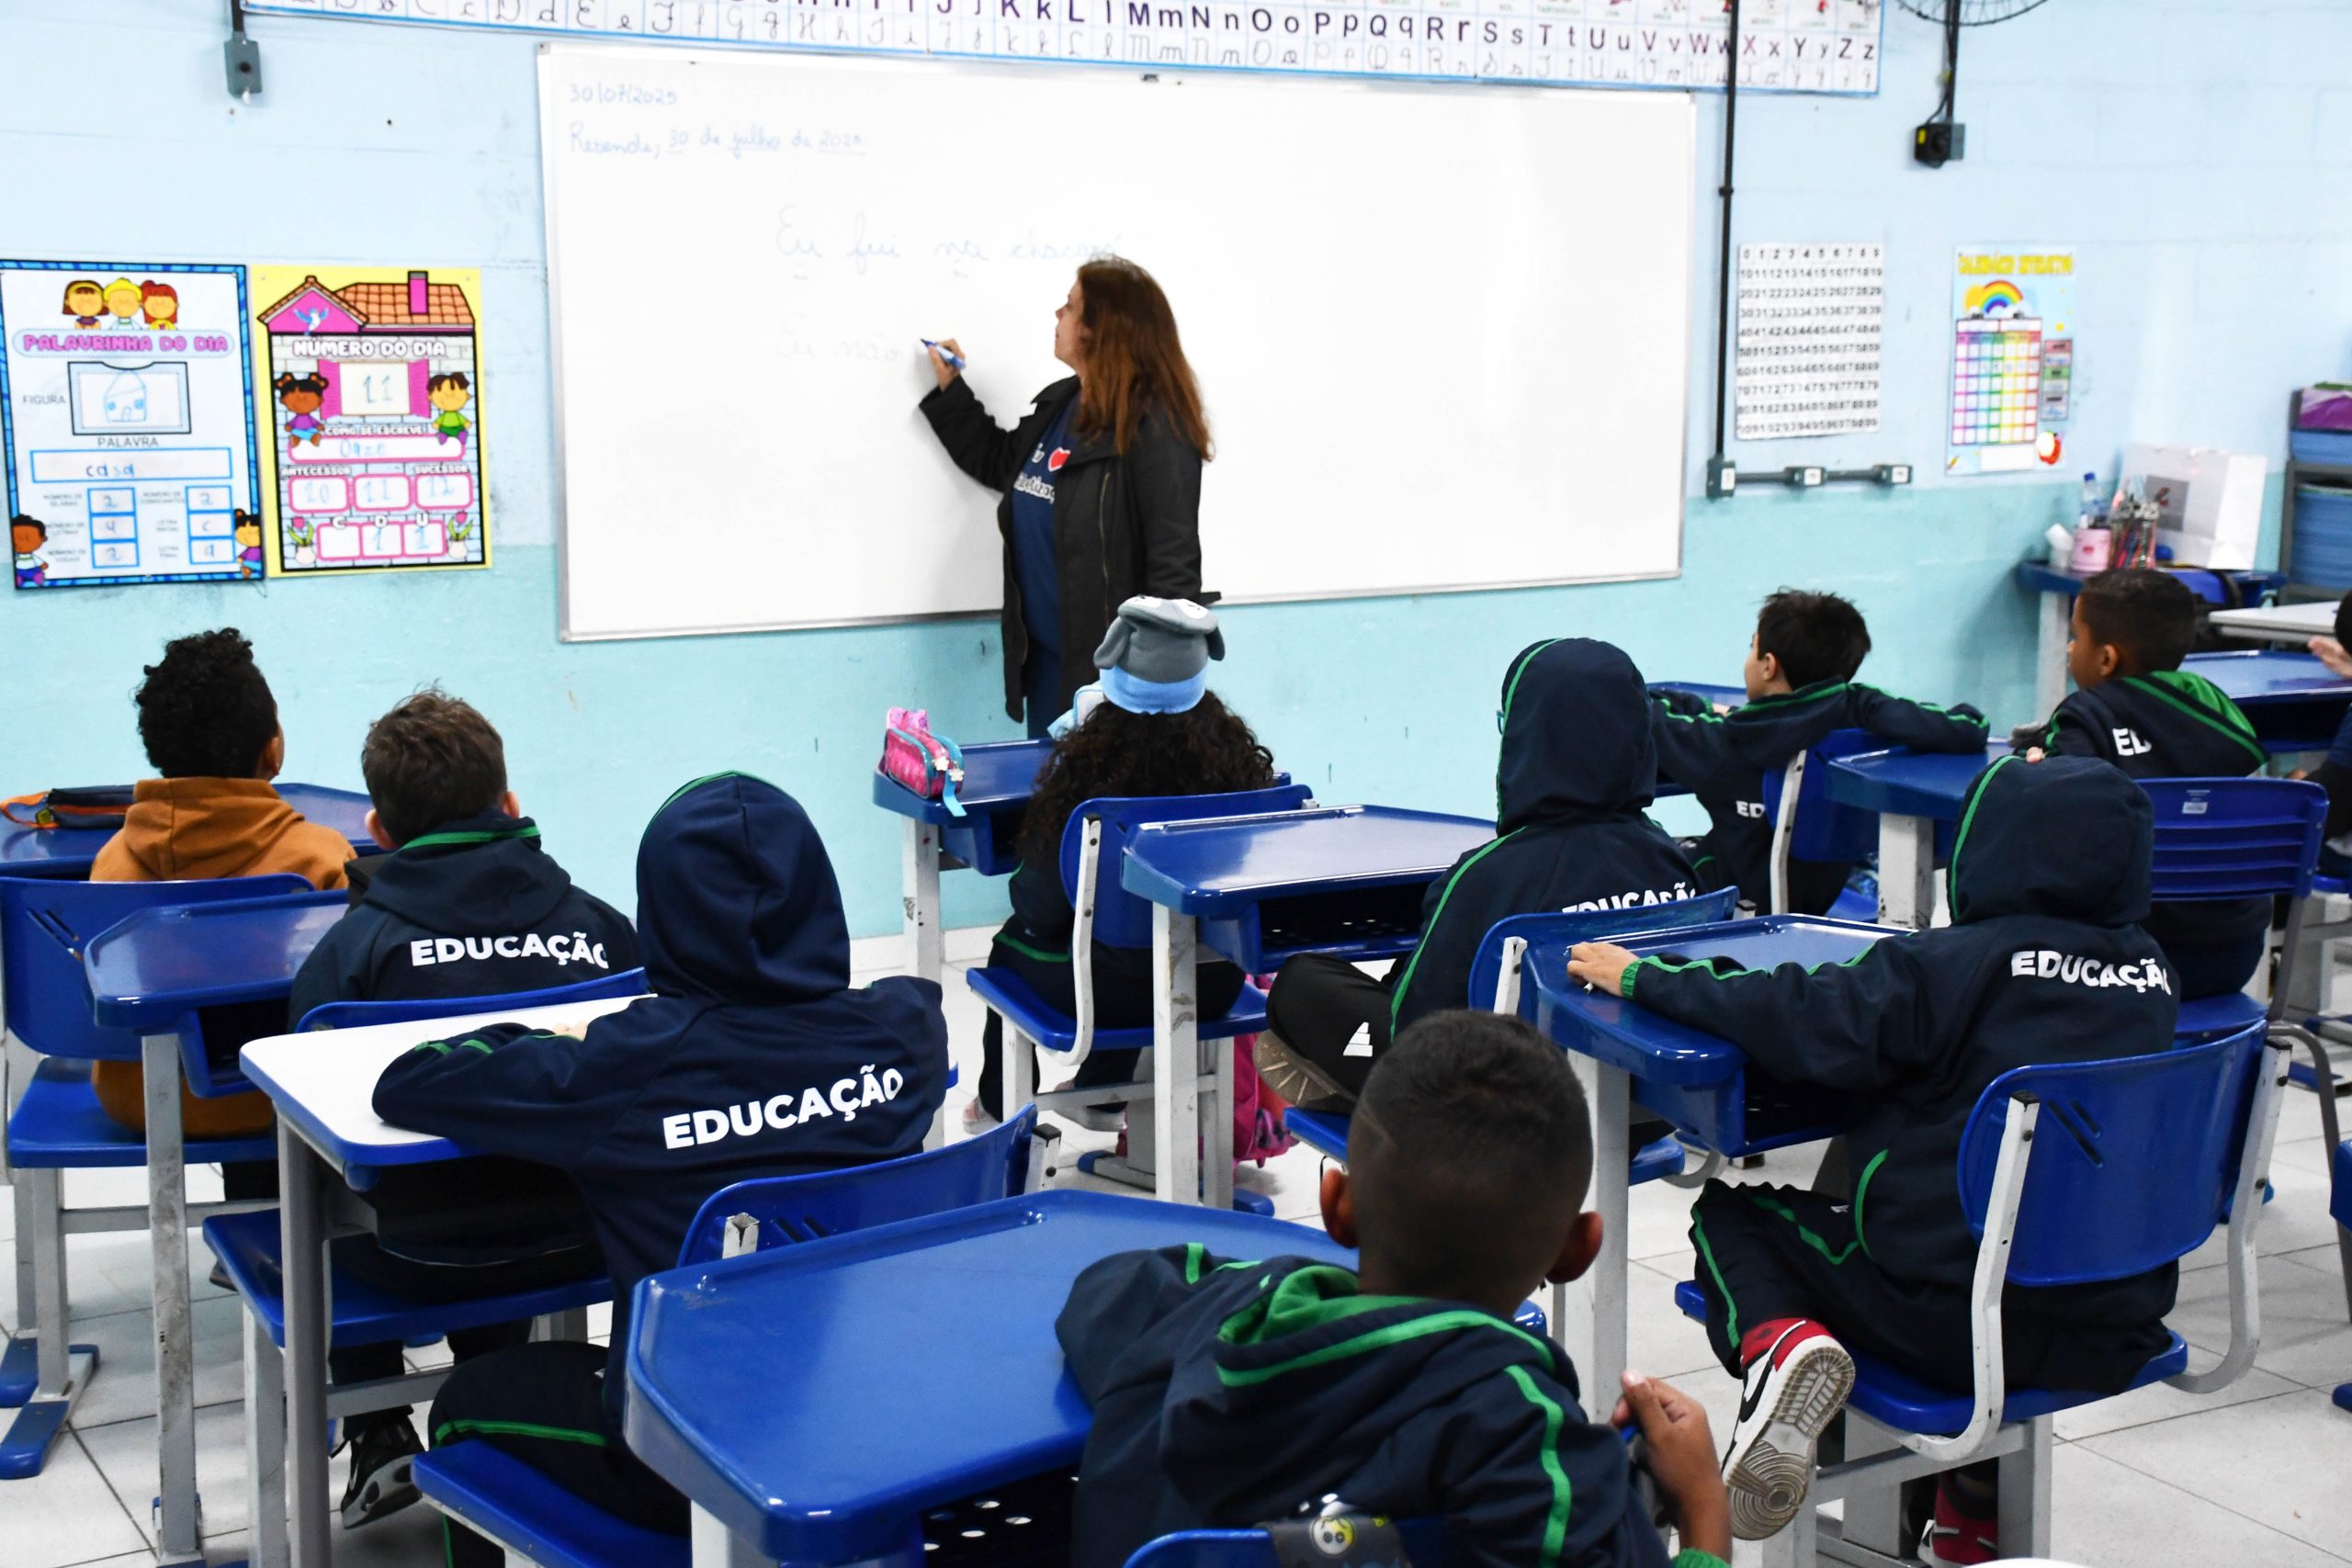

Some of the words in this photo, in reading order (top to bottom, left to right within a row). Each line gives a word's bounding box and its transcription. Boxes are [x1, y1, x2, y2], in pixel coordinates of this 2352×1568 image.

[1001, 0, 1020, 18] K
[1037, 0, 1051, 19] k
[1069, 0, 1084, 22] L
[1129, 3, 1149, 26] M
[1158, 9, 1182, 28] m
[1192, 6, 1210, 28] N
[1225, 14, 1239, 29] n
[1251, 8, 1272, 32] O
[1284, 16, 1299, 33] o
[1315, 12, 1330, 35] P
[1343, 15, 1359, 37] p
[1370, 15, 1387, 38] Q
[1399, 16, 1413, 39] q
[1427, 17, 1443, 40] R
[1458, 20, 1470, 41] r
[1483, 21, 1498, 43] S
[1511, 28, 1523, 45] s
[1539, 24, 1552, 46] T
[1568, 26, 1576, 47] t
[1589, 27, 1606, 51] U
[1618, 35, 1630, 51] u
[1642, 30, 1657, 51] V
[1668, 38, 1680, 52] v
[1690, 32, 1710, 54] W
[1743, 35, 1756, 55] X
[1769, 41, 1780, 57] x
[1793, 38, 1806, 58] Y
[1838, 38, 1852, 60] Z
[1863, 44, 1874, 60] z
[668, 128, 688, 147] 30
[699, 123, 720, 147] de
[775, 203, 822, 257] Eu
[23, 334, 153, 352] PALAVRINHA
[159, 335, 187, 352] DO
[194, 335, 229, 352] DIA
[292, 337, 374, 357] NÚMERO
[379, 342, 408, 356] DO
[413, 342, 447, 356] DIA
[363, 376, 394, 404] 11
[23, 395, 66, 405] FIGURA
[97, 437, 159, 447] PALAVRA
[86, 463, 135, 478] casa
[103, 495, 119, 508] 2
[199, 493, 213, 506] 2
[332, 515, 347, 529] C
[374, 514, 387, 528] D
[416, 513, 429, 526] U
[106, 547, 122, 561] 2
[2011, 950, 2172, 995] EDUCAÇÃ
[663, 1064, 903, 1150] EDUCAÇÃO
